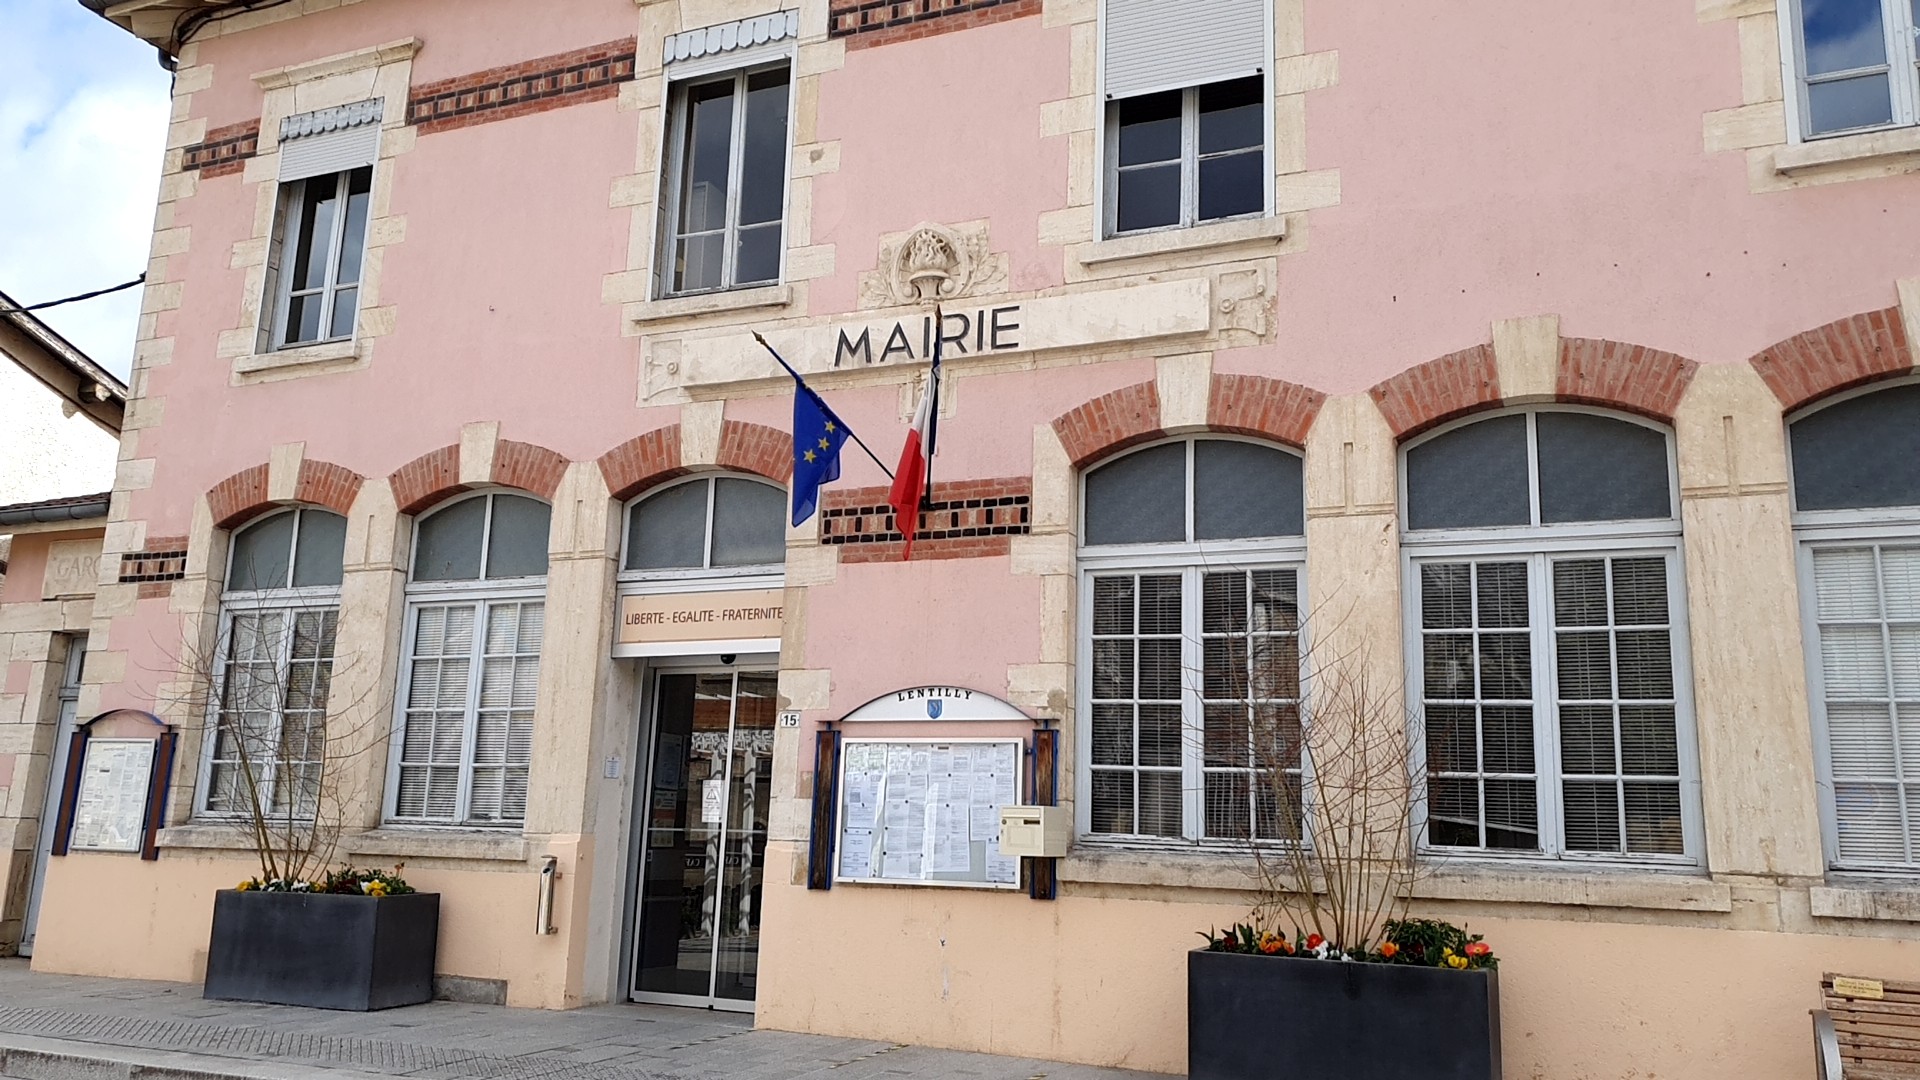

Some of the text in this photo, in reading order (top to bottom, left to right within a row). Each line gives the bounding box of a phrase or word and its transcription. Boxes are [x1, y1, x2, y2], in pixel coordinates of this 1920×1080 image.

[834, 305, 1020, 367] MAIRIE
[626, 612, 664, 625] LIBERTE
[672, 610, 714, 623] EGALITE
[722, 606, 783, 621] FRATERNITE
[898, 688, 972, 702] LENTILLY
[783, 714, 797, 726] 15
